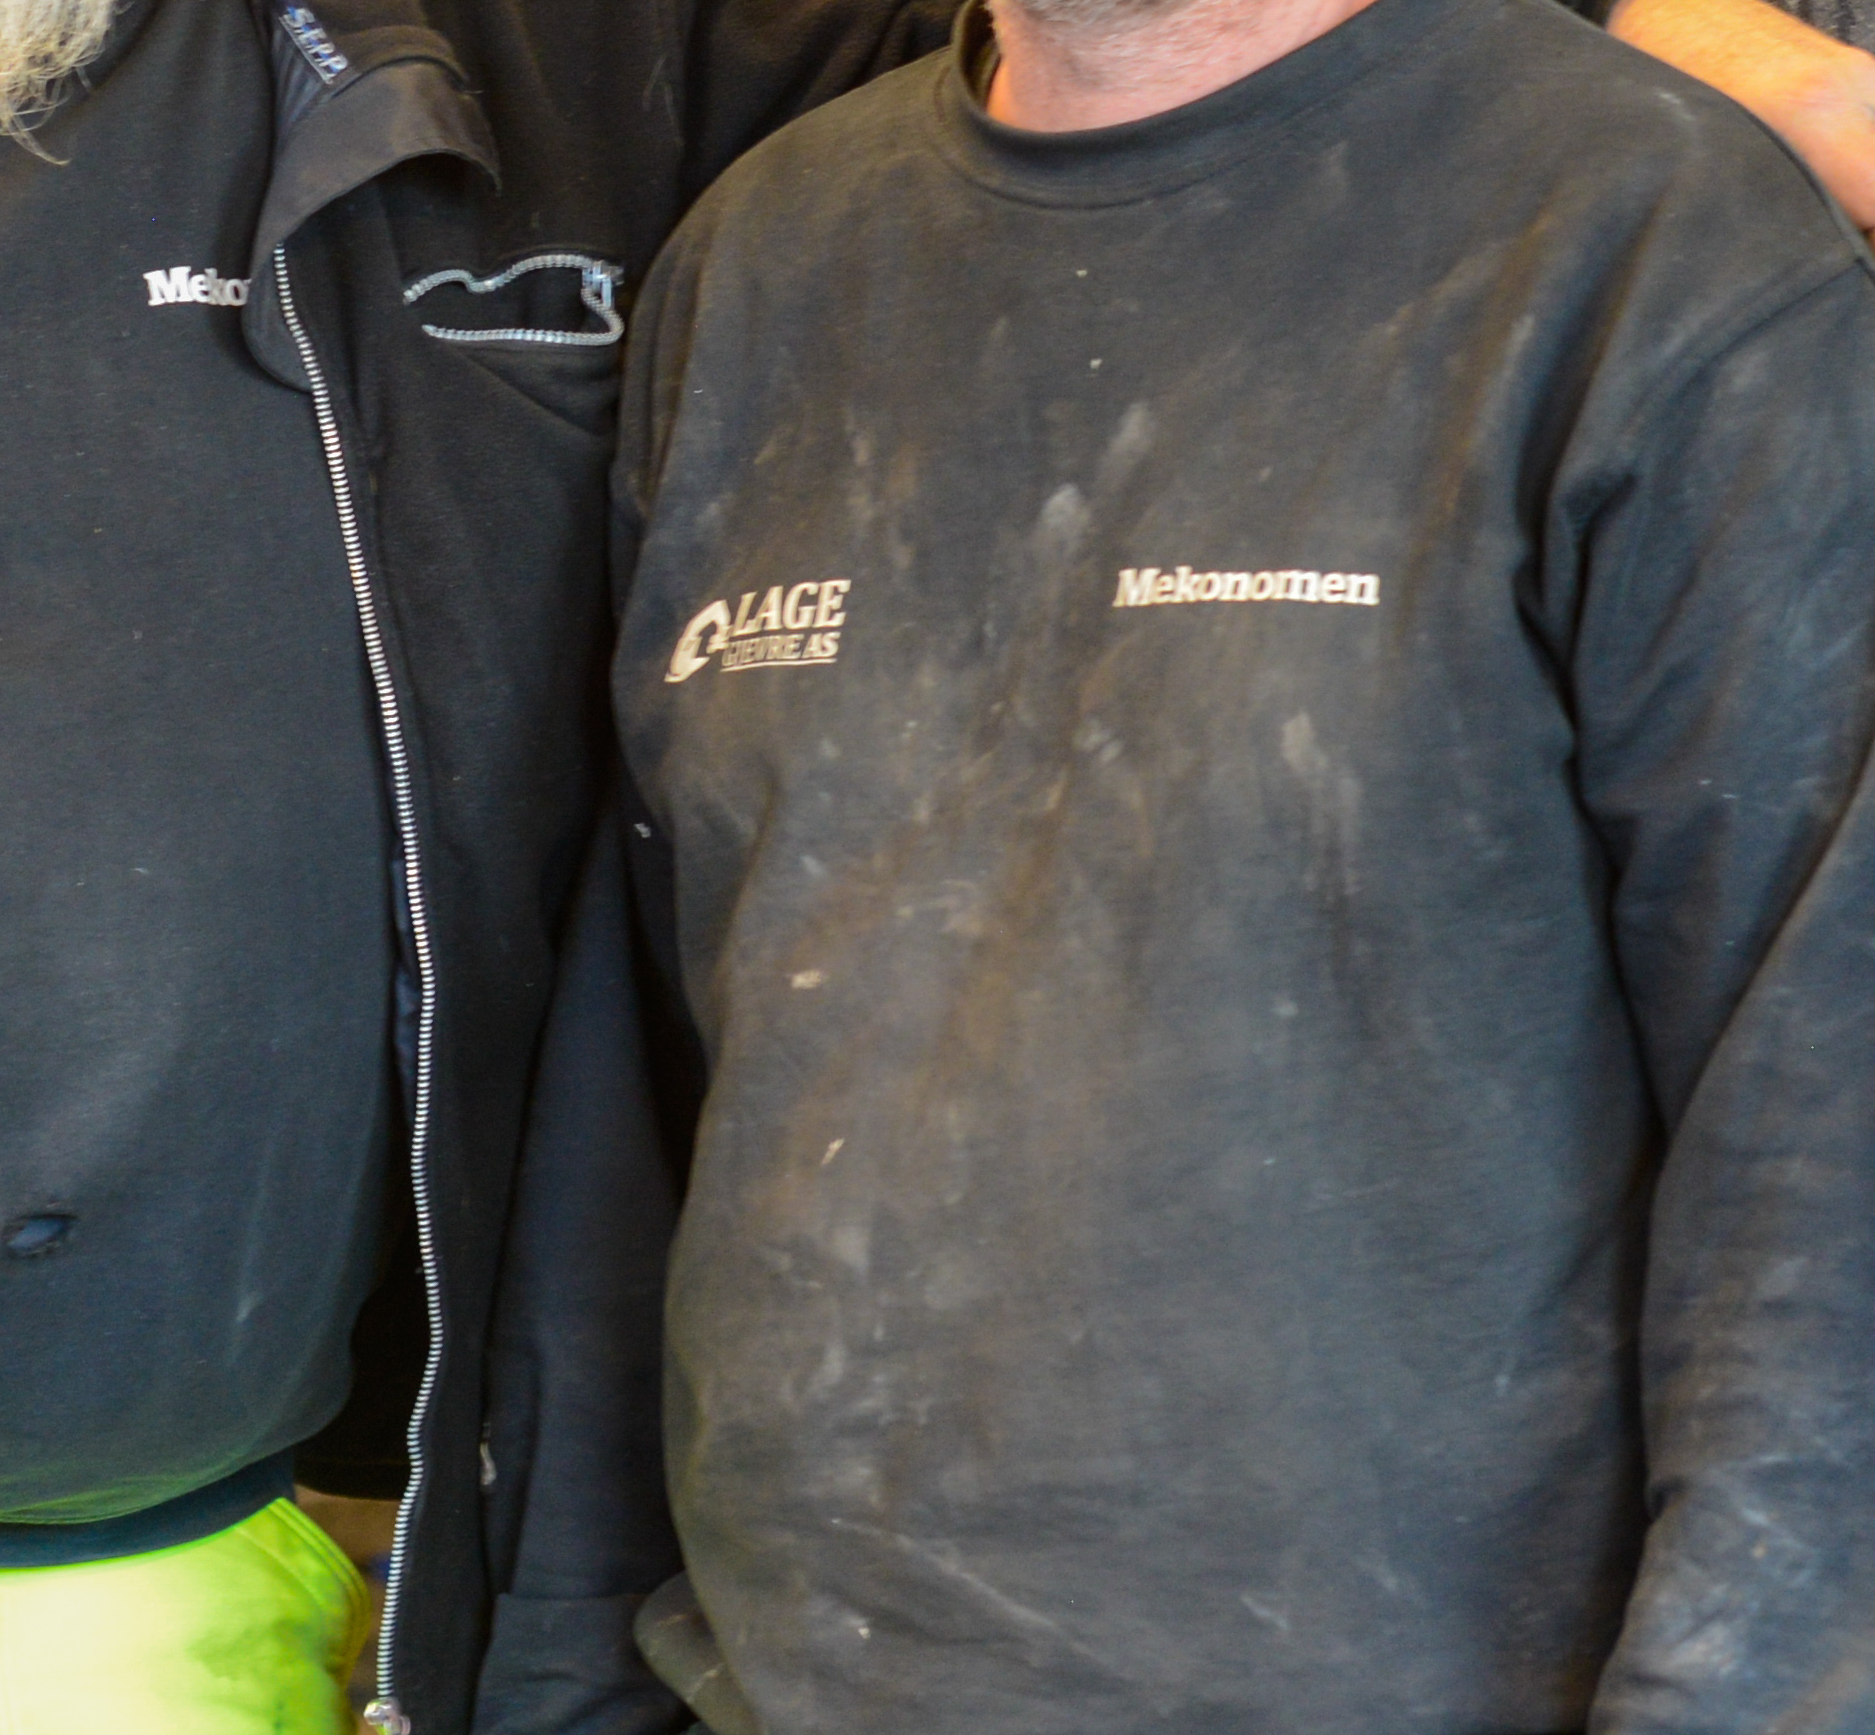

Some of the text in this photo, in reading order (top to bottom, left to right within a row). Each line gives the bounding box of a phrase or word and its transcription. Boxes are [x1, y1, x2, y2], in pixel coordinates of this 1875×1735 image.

[143, 266, 252, 306] Meko
[1112, 565, 1380, 606] Mekonomen
[731, 579, 852, 636] LAGE
[802, 631, 841, 658] AS
